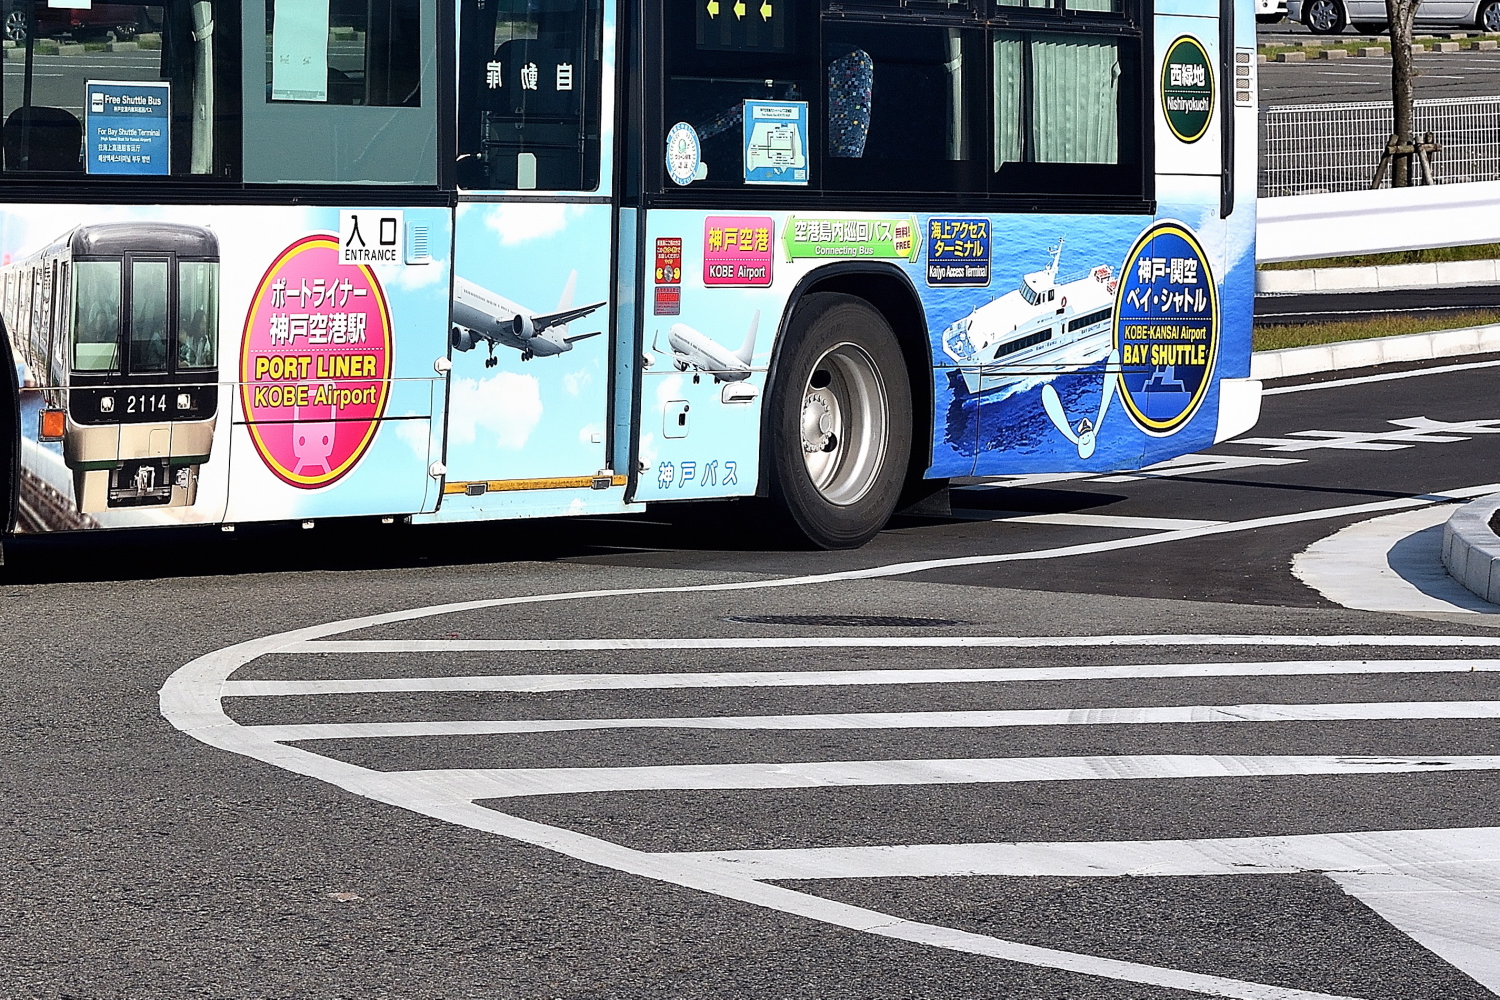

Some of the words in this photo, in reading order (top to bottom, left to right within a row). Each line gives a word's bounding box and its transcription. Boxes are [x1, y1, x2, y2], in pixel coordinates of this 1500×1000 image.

[1170, 64, 1205, 87] 西緑地
[105, 95, 120, 104] Free
[122, 95, 147, 105] Shuttle
[148, 96, 161, 106] Bus
[1167, 96, 1209, 115] Nishiryokuchi
[97, 128, 106, 136] For
[108, 128, 117, 137] Bay
[118, 128, 137, 136] Shuttle
[138, 129, 160, 137] Terminal
[346, 214, 396, 247] 入口
[794, 220, 893, 243] 空港島内巡回バス
[931, 221, 987, 239] 海上アクセス
[708, 227, 769, 252] 神戸空港
[895, 240, 911, 250] FREE
[934, 240, 984, 257] ターミナル
[345, 249, 396, 261] ENTRANCE
[815, 245, 857, 258] Connecting
[859, 245, 874, 255] Bus
[709, 265, 734, 278] KOBE
[738, 265, 766, 280] Airport
[946, 265, 965, 278] Access
[965, 265, 988, 278] Terminal
[271, 277, 367, 308] ポートライナー
[269, 312, 367, 346] 神戸空港駅
[1124, 325, 1180, 340] KOBE-KANSAI
[1180, 325, 1206, 343] Airport
[1123, 344, 1149, 365] BAY
[1151, 344, 1206, 366] SHUTTLE
[255, 355, 312, 380] PORT
[316, 355, 377, 379] LINER
[127, 395, 167, 413] 2114
[254, 385, 309, 407] KOBE
[313, 384, 377, 410] Airport
[658, 459, 738, 489] 神戸バス
